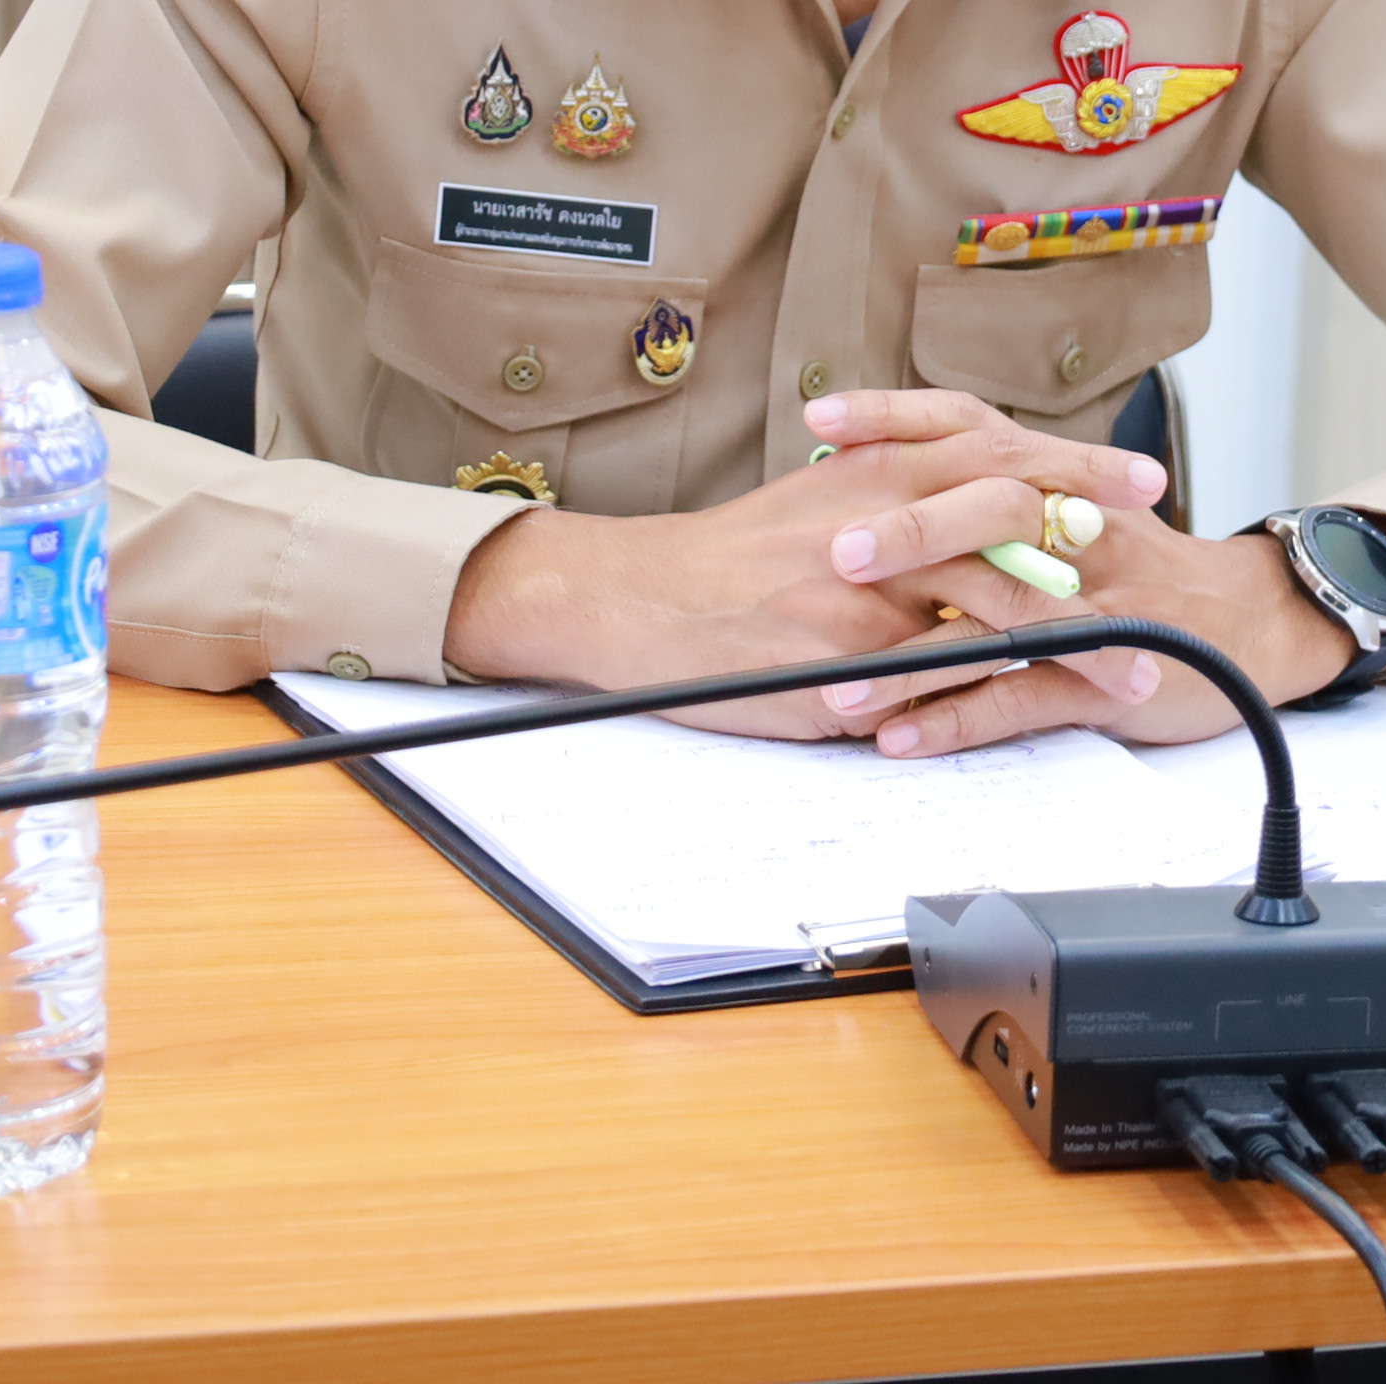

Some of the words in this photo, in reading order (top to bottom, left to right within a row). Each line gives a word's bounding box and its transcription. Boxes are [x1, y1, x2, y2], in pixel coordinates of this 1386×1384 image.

[472, 200, 554, 223] นายเวสารัช
[1277, 993, 1306, 1006] LINE
[1064, 1123, 1097, 1136] Made
[1063, 1141, 1095, 1153] Made
[1097, 1140, 1111, 1152] by
[1114, 1138, 1140, 1150] NPE
